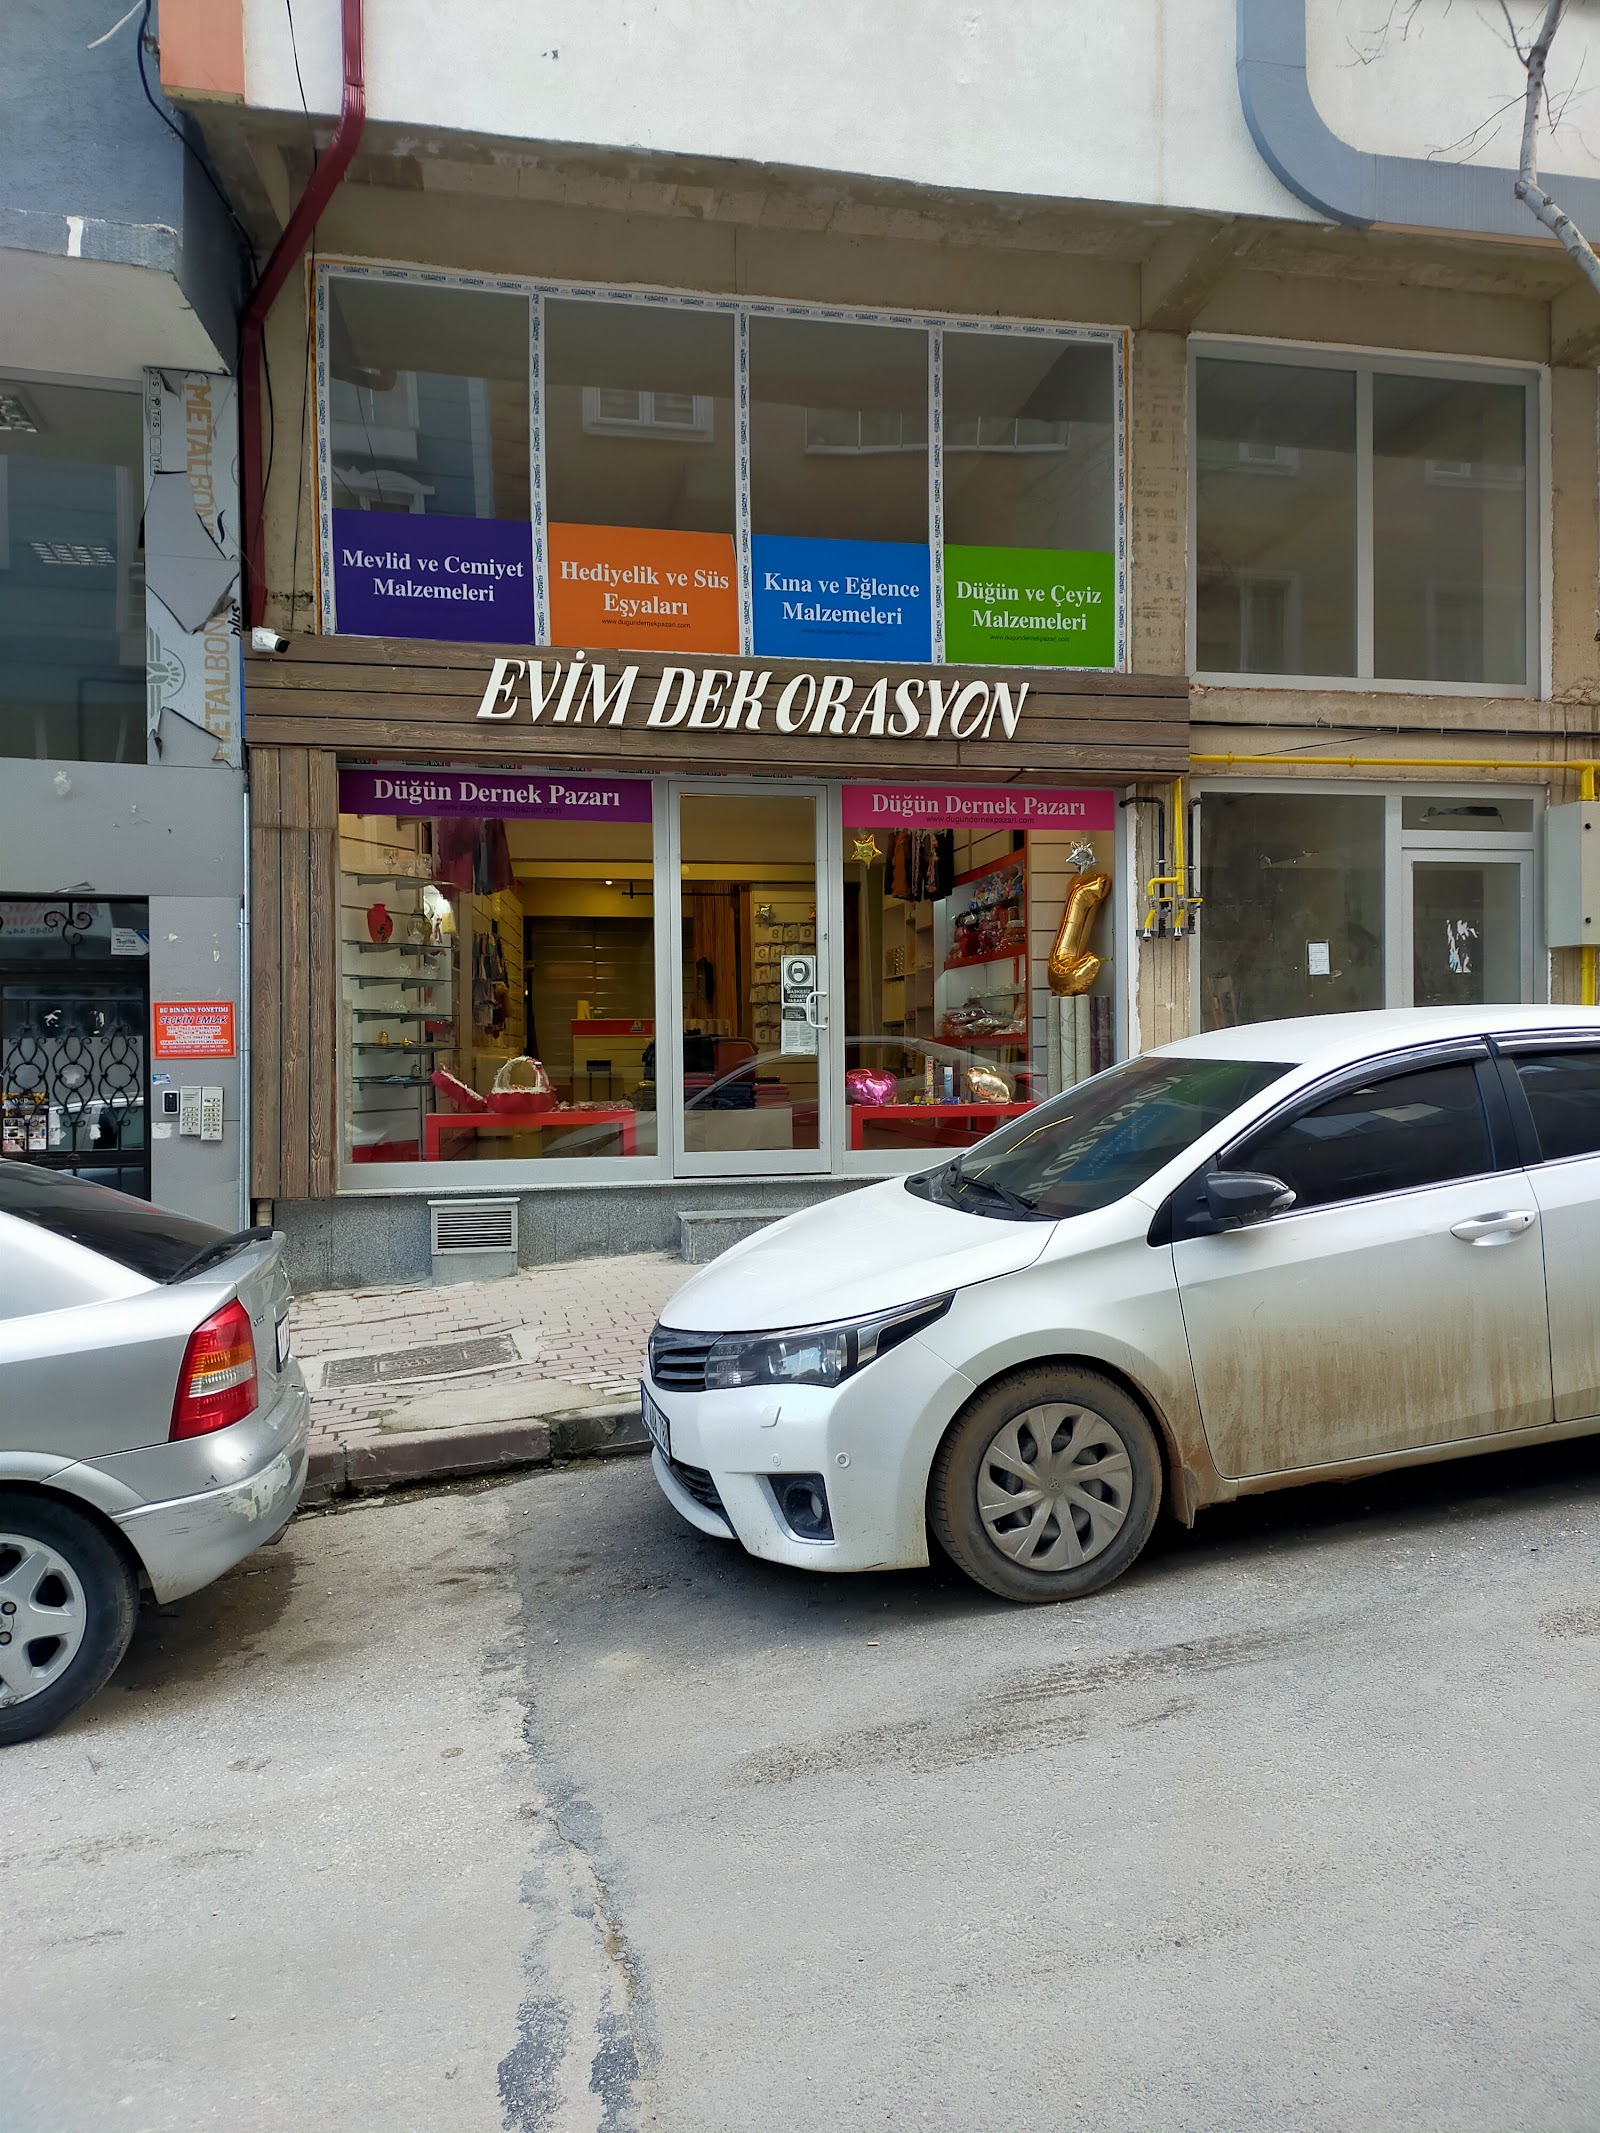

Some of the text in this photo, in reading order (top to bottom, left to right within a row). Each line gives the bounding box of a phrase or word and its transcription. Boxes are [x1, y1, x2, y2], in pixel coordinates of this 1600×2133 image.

[186, 383, 214, 535] METALBON
[341, 549, 524, 580] Mevlid ve Cemiyet
[560, 561, 730, 590] Hediyelik ve Süs
[373, 578, 495, 603] Malzemeleri
[763, 572, 920, 599] Kına ve Eğlence
[956, 581, 1102, 607] Düğün ve Çeyiz
[602, 593, 689, 618] Eşyaları
[782, 601, 902, 625] Malzemeleri
[972, 609, 1087, 631] Malzemeleri
[476, 649, 640, 726] EVİM
[373, 778, 621, 806] Düğün Dernek Pazarı
[872, 793, 1085, 817] Düğün Dernek Pazarı
[926, 815, 1034, 825] www.dugundernekpazari.com
[196, 1015, 227, 1024] EMLAK
